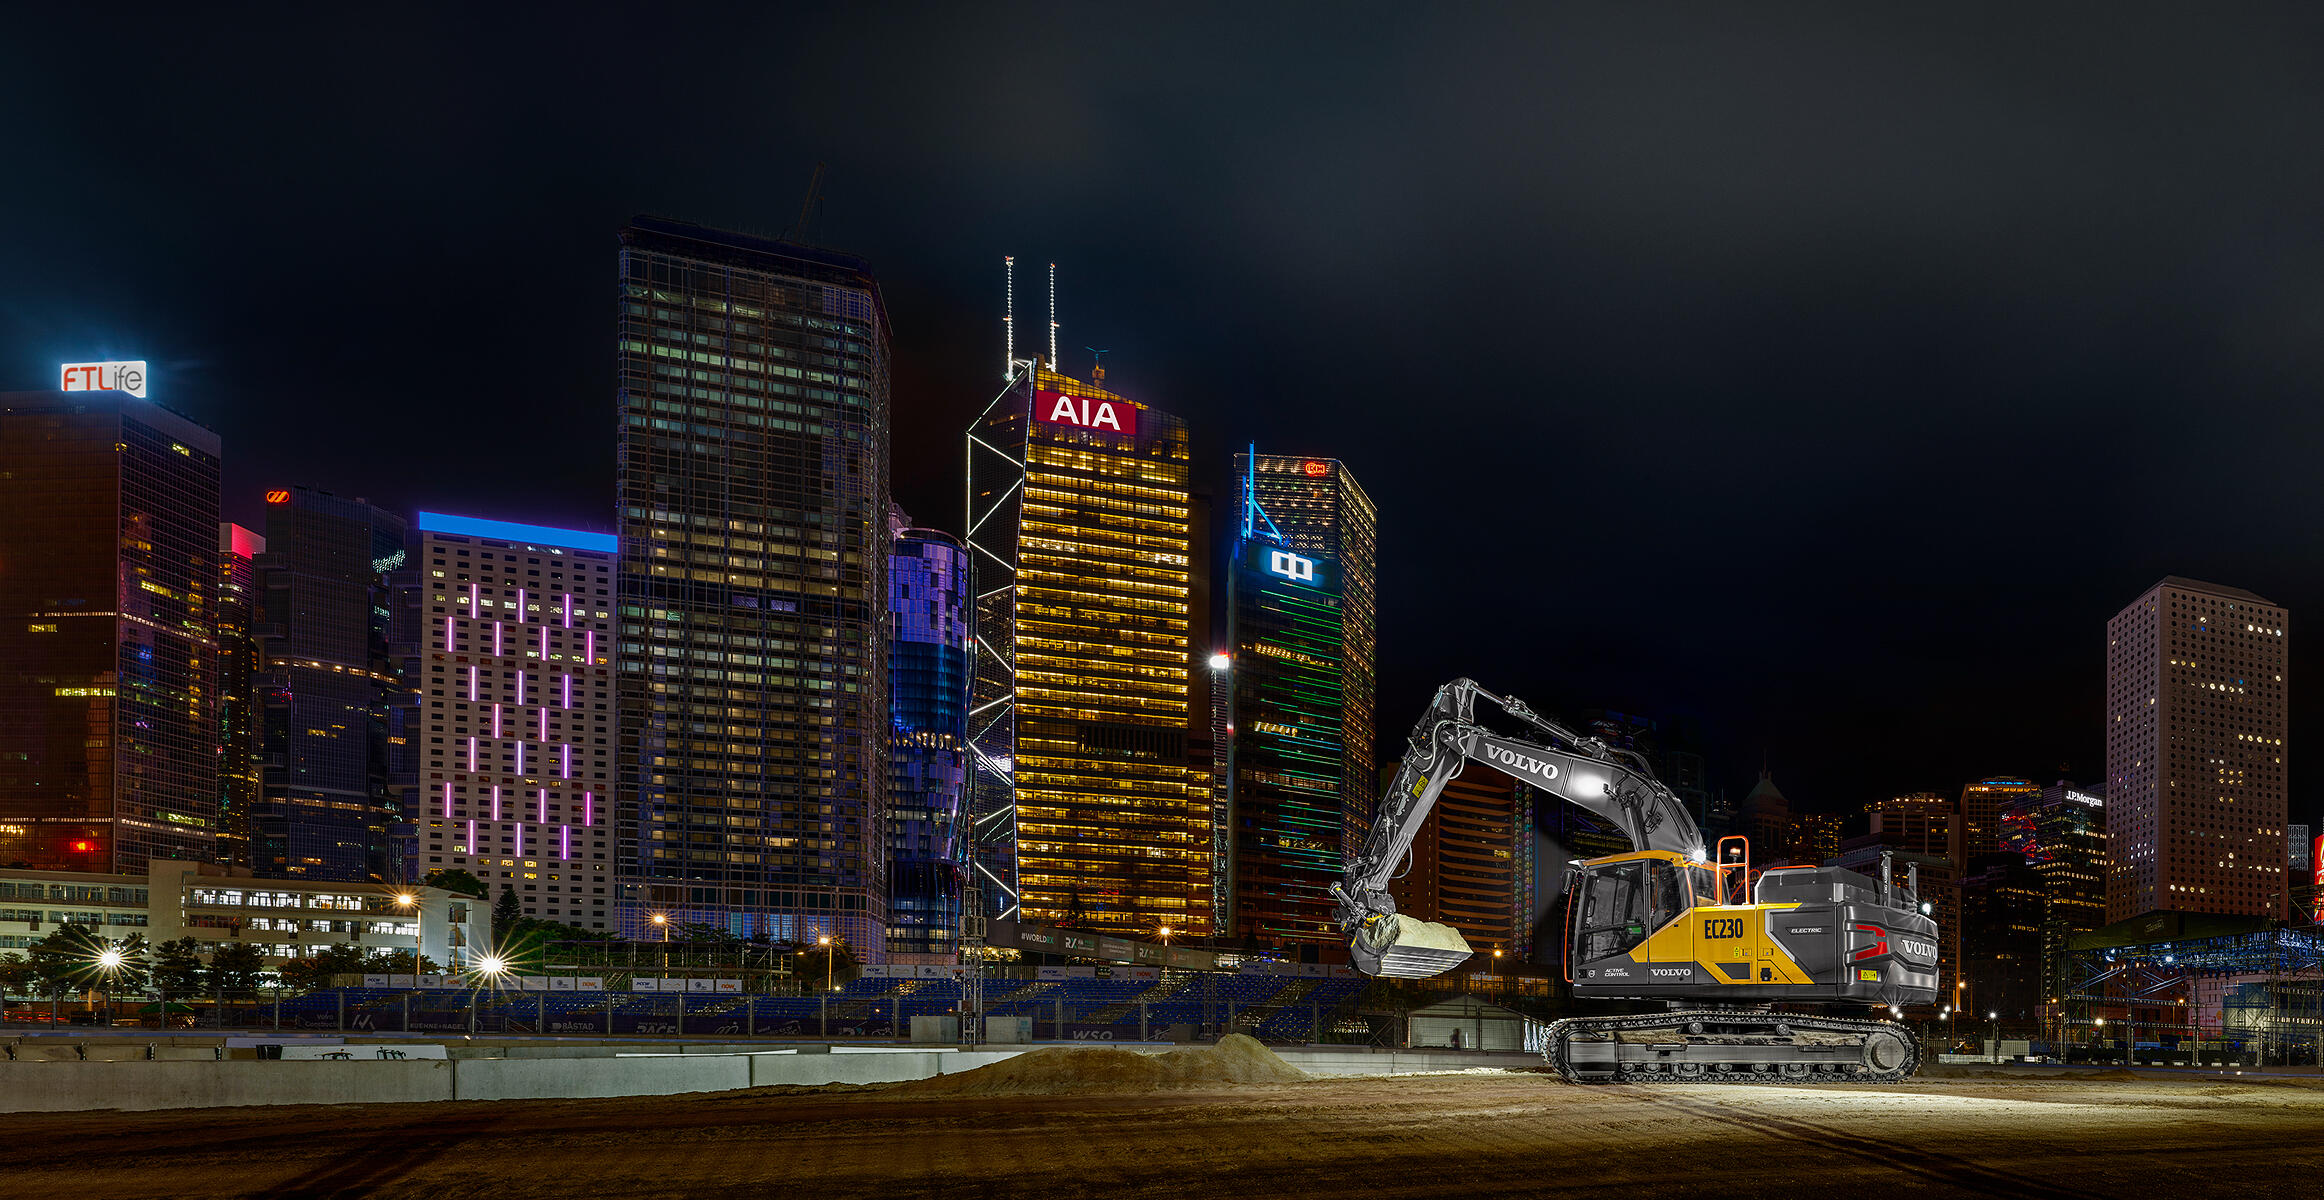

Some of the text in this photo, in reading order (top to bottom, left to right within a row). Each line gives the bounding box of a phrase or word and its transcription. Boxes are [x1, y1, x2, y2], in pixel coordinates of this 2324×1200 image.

[64, 365, 142, 391] FTLife
[1050, 396, 1120, 431] AIA
[1485, 743, 1559, 780] VOLVO
[1704, 918, 1744, 940] EC230
[1902, 939, 1936, 958] VOLVO
[1650, 968, 1692, 977] VOLVO
